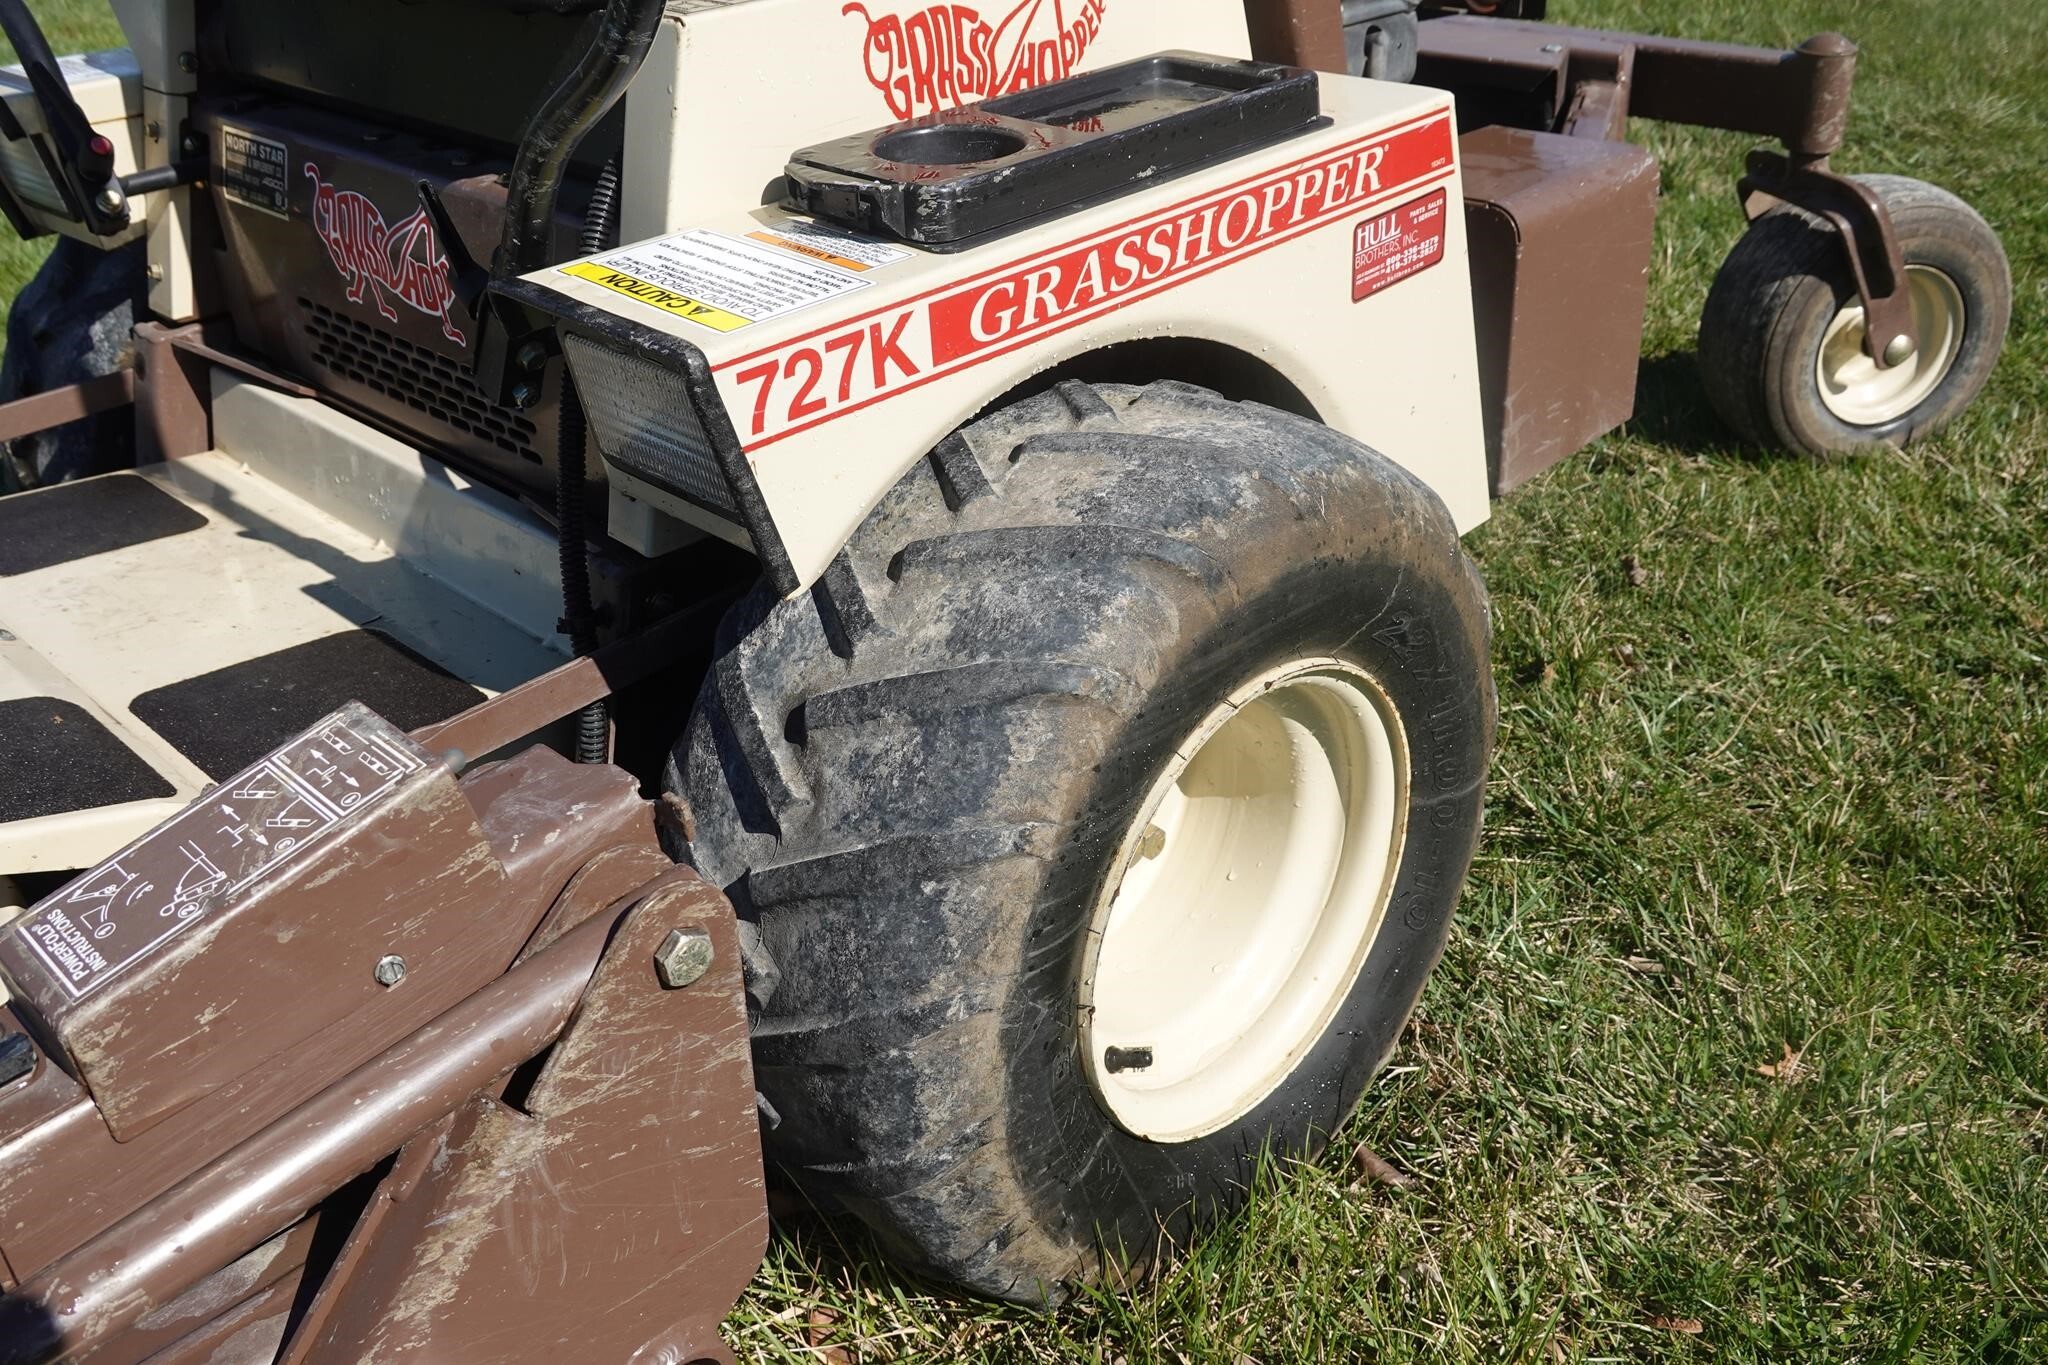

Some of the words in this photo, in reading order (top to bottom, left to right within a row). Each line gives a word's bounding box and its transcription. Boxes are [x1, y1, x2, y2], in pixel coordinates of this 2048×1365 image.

[226, 134, 257, 156] NORTH
[259, 145, 284, 165] STAR
[1410, 206, 1426, 218] PARTS
[970, 146, 1384, 342] GRASSHOPPER
[1357, 213, 1401, 253] HULL
[606, 260, 647, 275] INJURY
[601, 274, 690, 308] CAUTION
[644, 274, 703, 295] SERIOUS
[700, 293, 741, 308] AVOID
[740, 307, 762, 317] TO
[736, 310, 920, 436] 727K
[47, 908, 108, 972] INSTRUCTIONS
